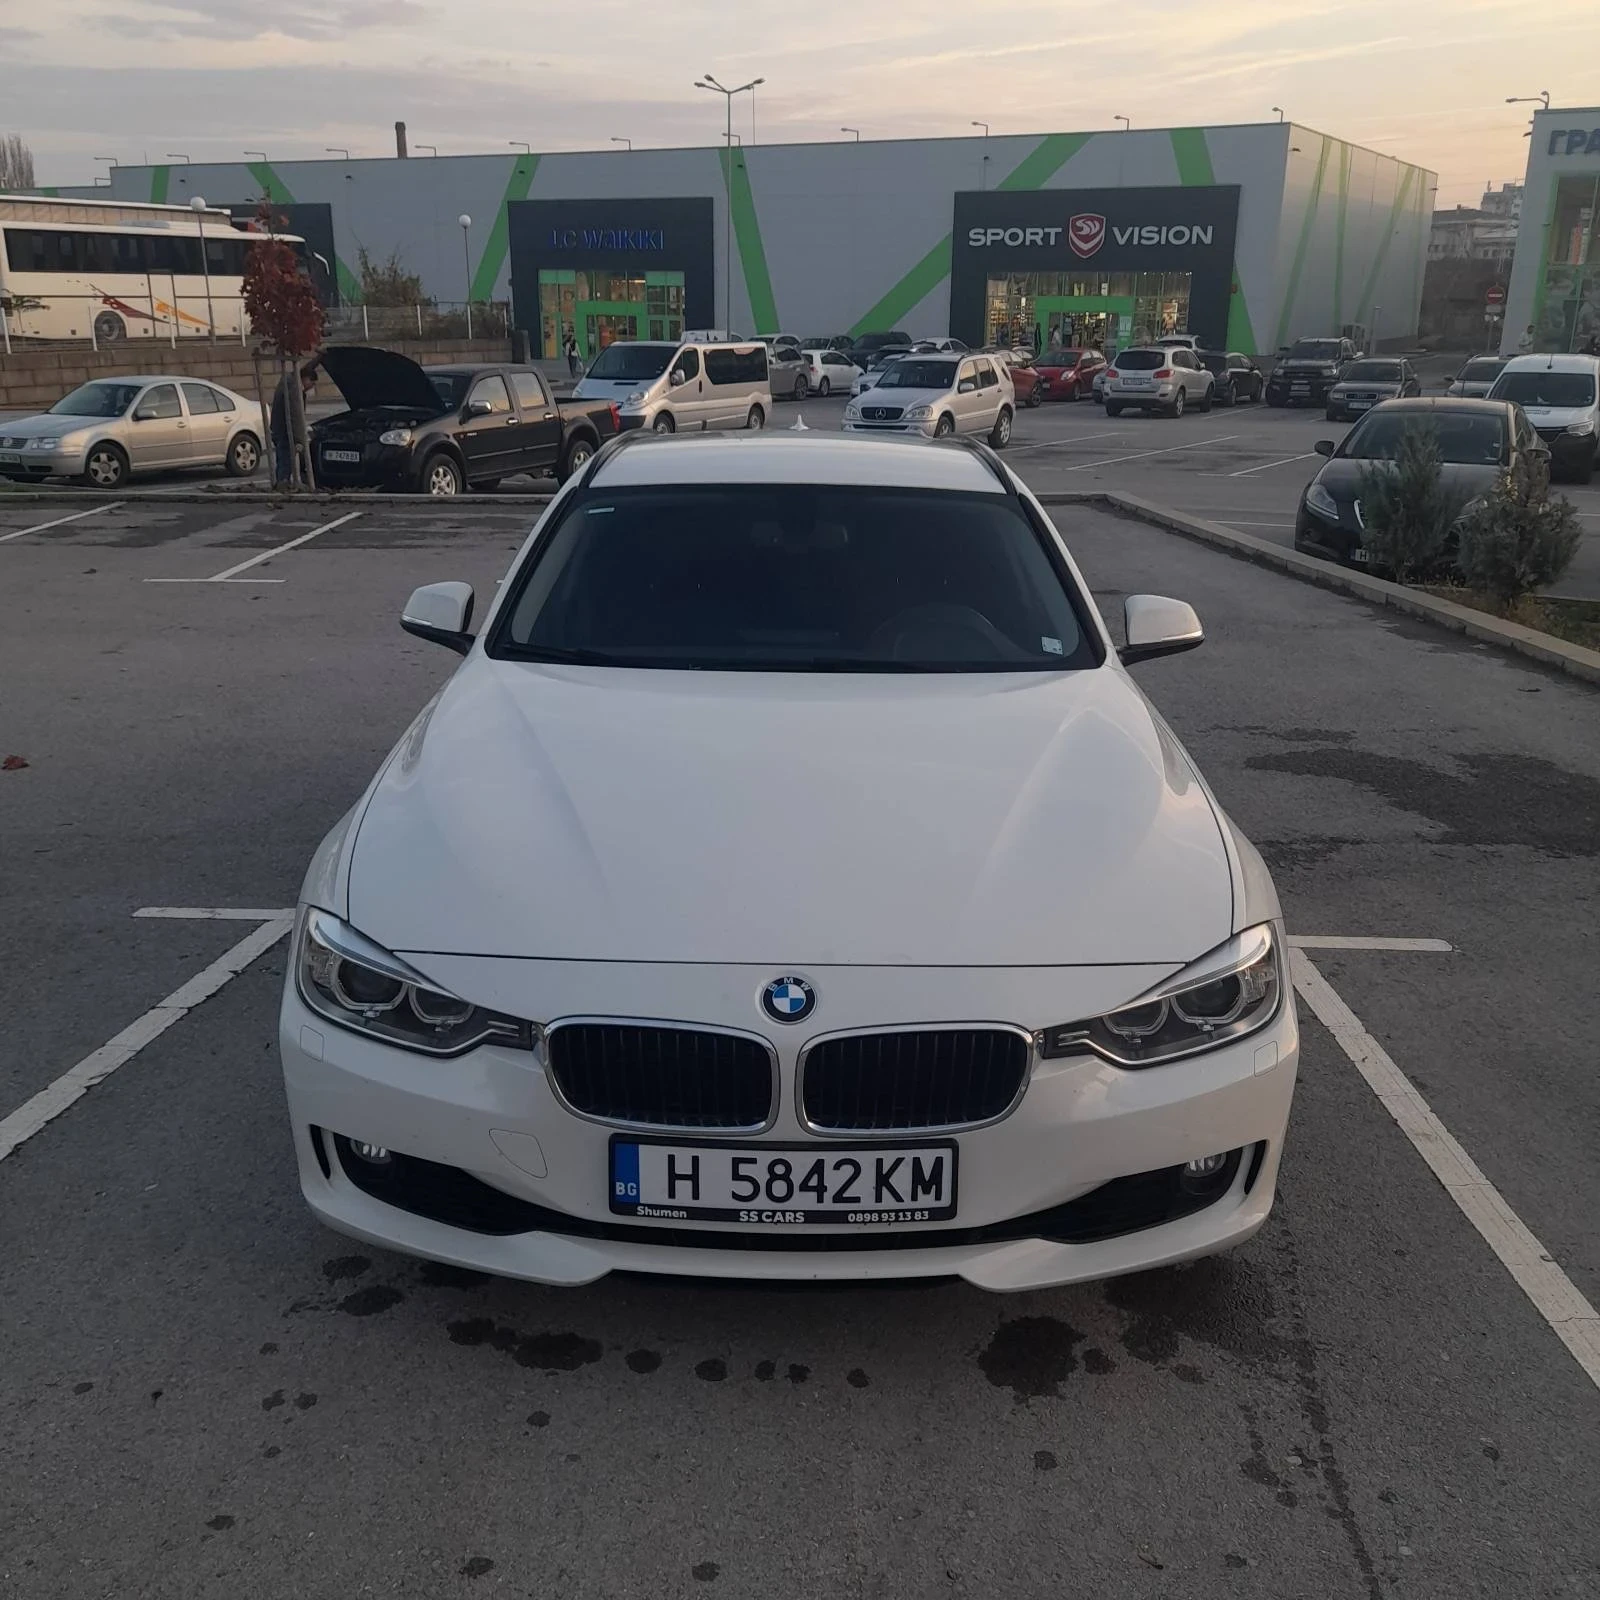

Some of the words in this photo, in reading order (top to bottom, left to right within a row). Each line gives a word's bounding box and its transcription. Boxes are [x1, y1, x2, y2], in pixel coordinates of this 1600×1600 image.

[968, 227, 1063, 247] SPORT
[1112, 225, 1213, 246] VISION
[768, 977, 811, 992] BMW
[667, 1154, 700, 1201] H
[615, 1182, 637, 1196] BG
[636, 1206, 687, 1218] Shumen
[761, 1211, 805, 1223] CARS
[848, 1212, 879, 1222] 0898
